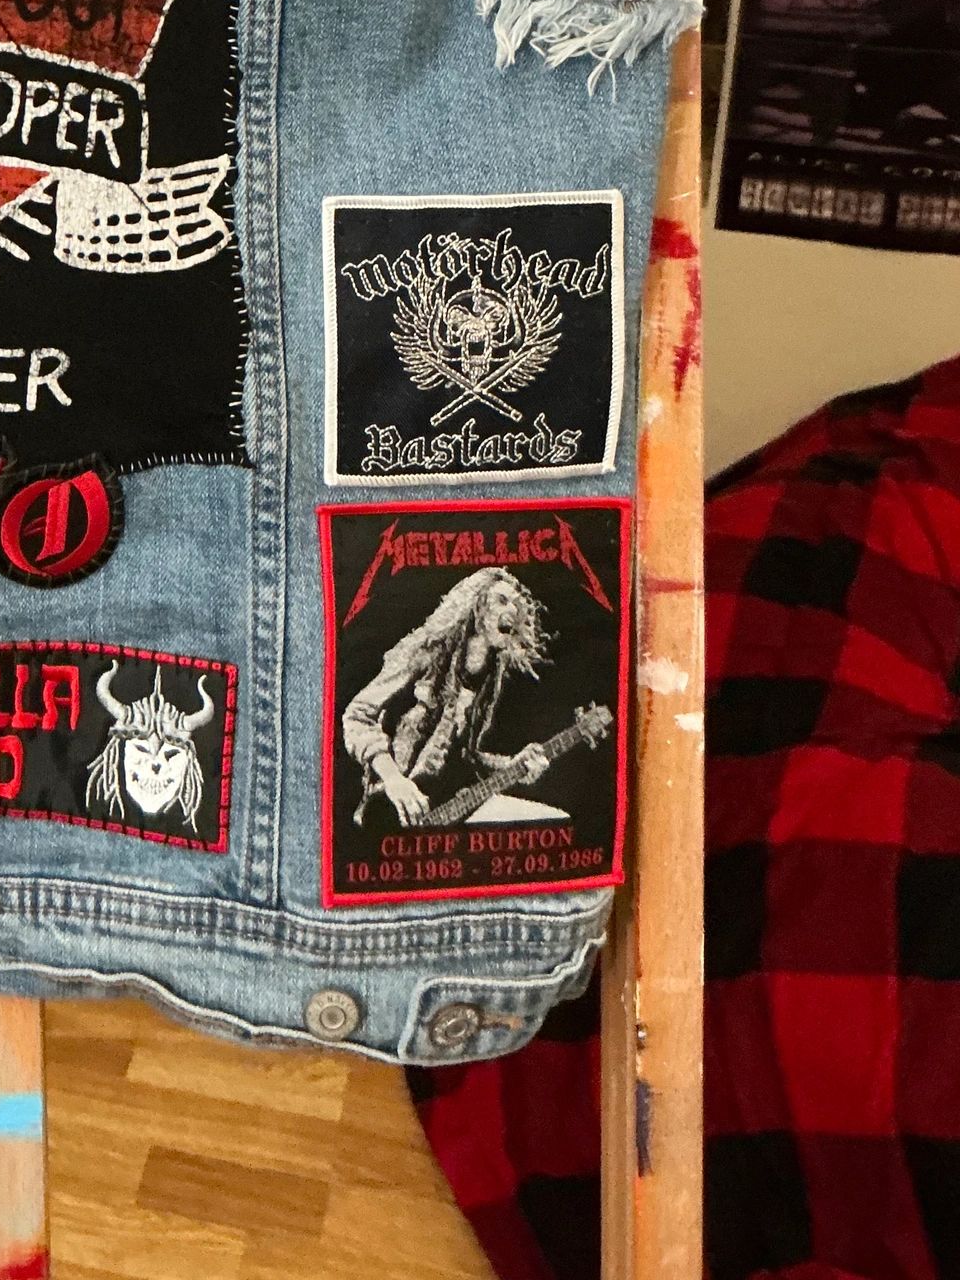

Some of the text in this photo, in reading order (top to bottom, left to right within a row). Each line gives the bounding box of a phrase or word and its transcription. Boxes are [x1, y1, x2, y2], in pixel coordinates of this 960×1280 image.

[361, 412, 583, 472] Bastards
[343, 513, 615, 628] METALLICA
[381, 825, 575, 858] CLIFF BURTON
